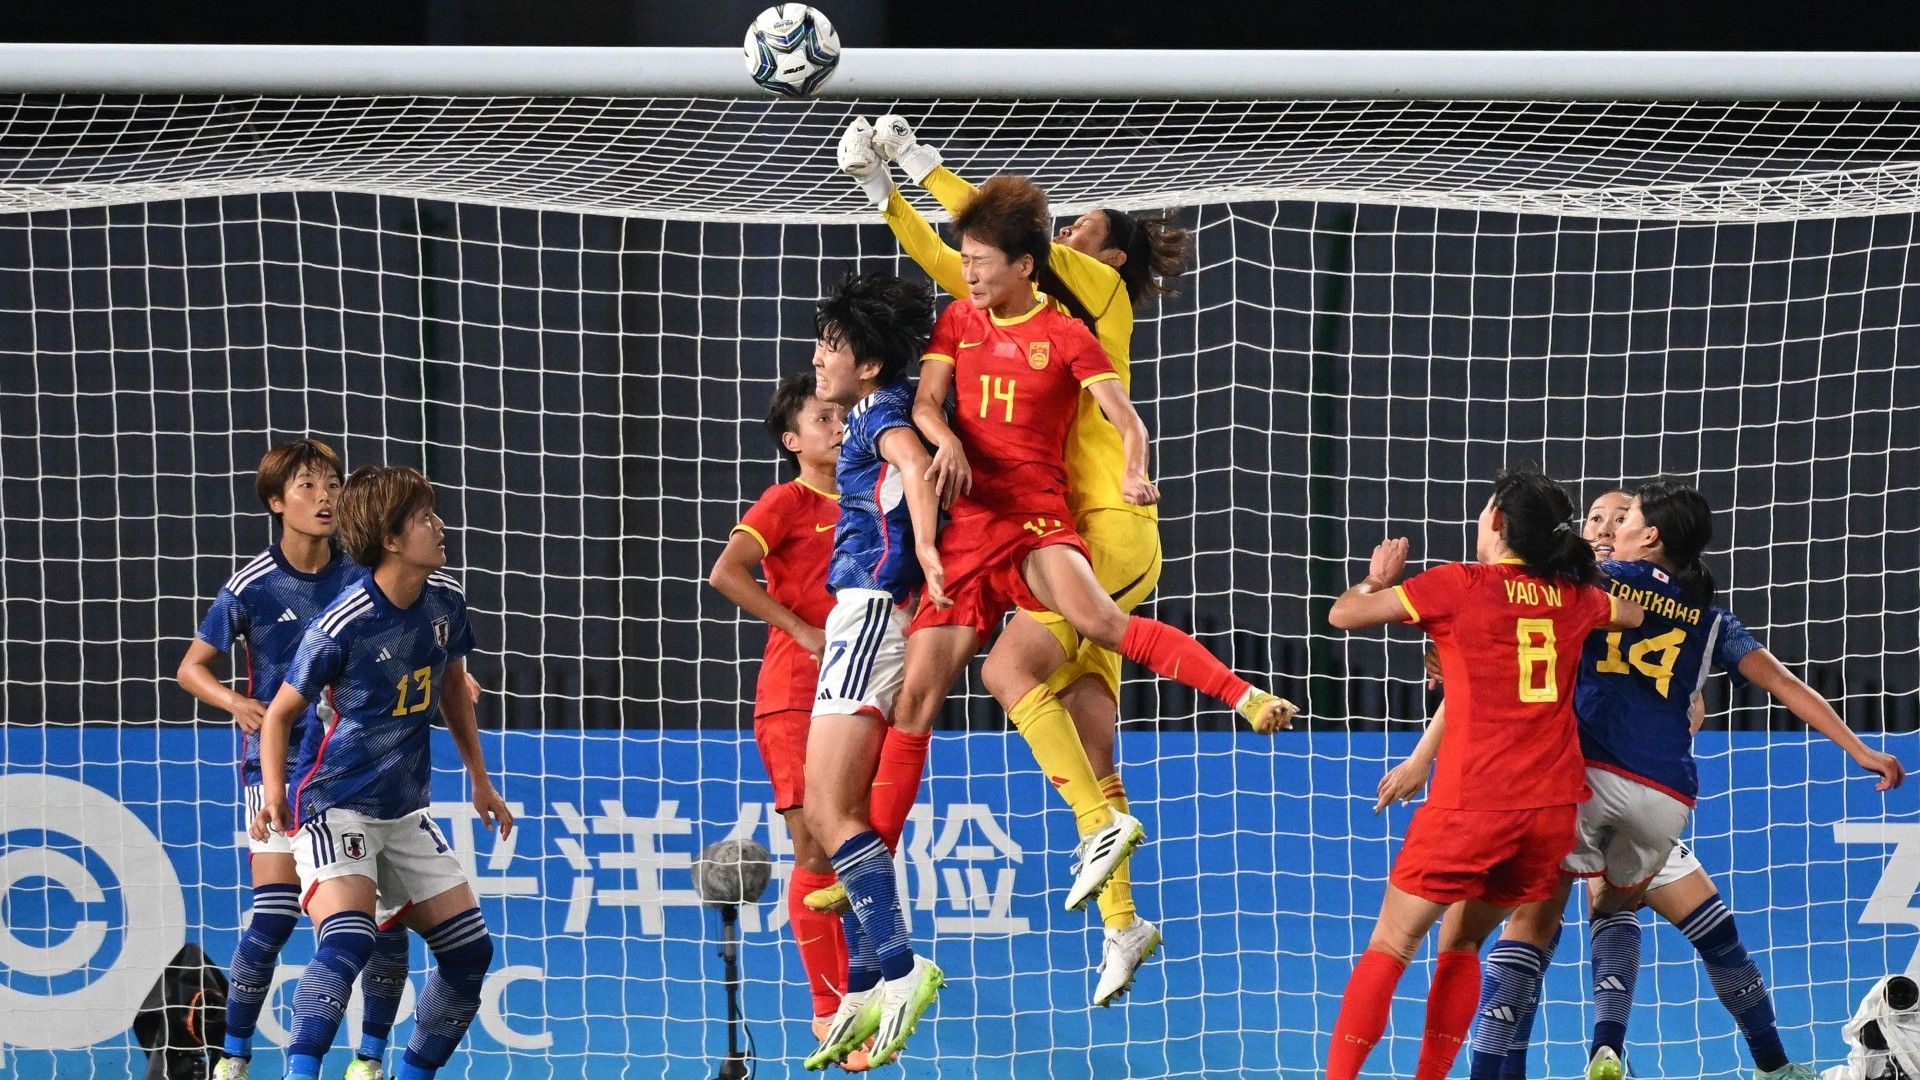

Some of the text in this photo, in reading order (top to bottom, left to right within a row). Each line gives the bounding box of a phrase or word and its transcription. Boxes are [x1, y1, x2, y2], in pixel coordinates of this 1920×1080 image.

[979, 374, 1016, 423] 14
[1504, 579, 1562, 607] YAO W
[1610, 578, 1701, 626] TANIKAWA
[820, 640, 847, 682] 7
[1516, 617, 1559, 703] 8
[1596, 627, 1687, 699] 14
[391, 665, 431, 717] 13
[418, 811, 450, 854] 1
